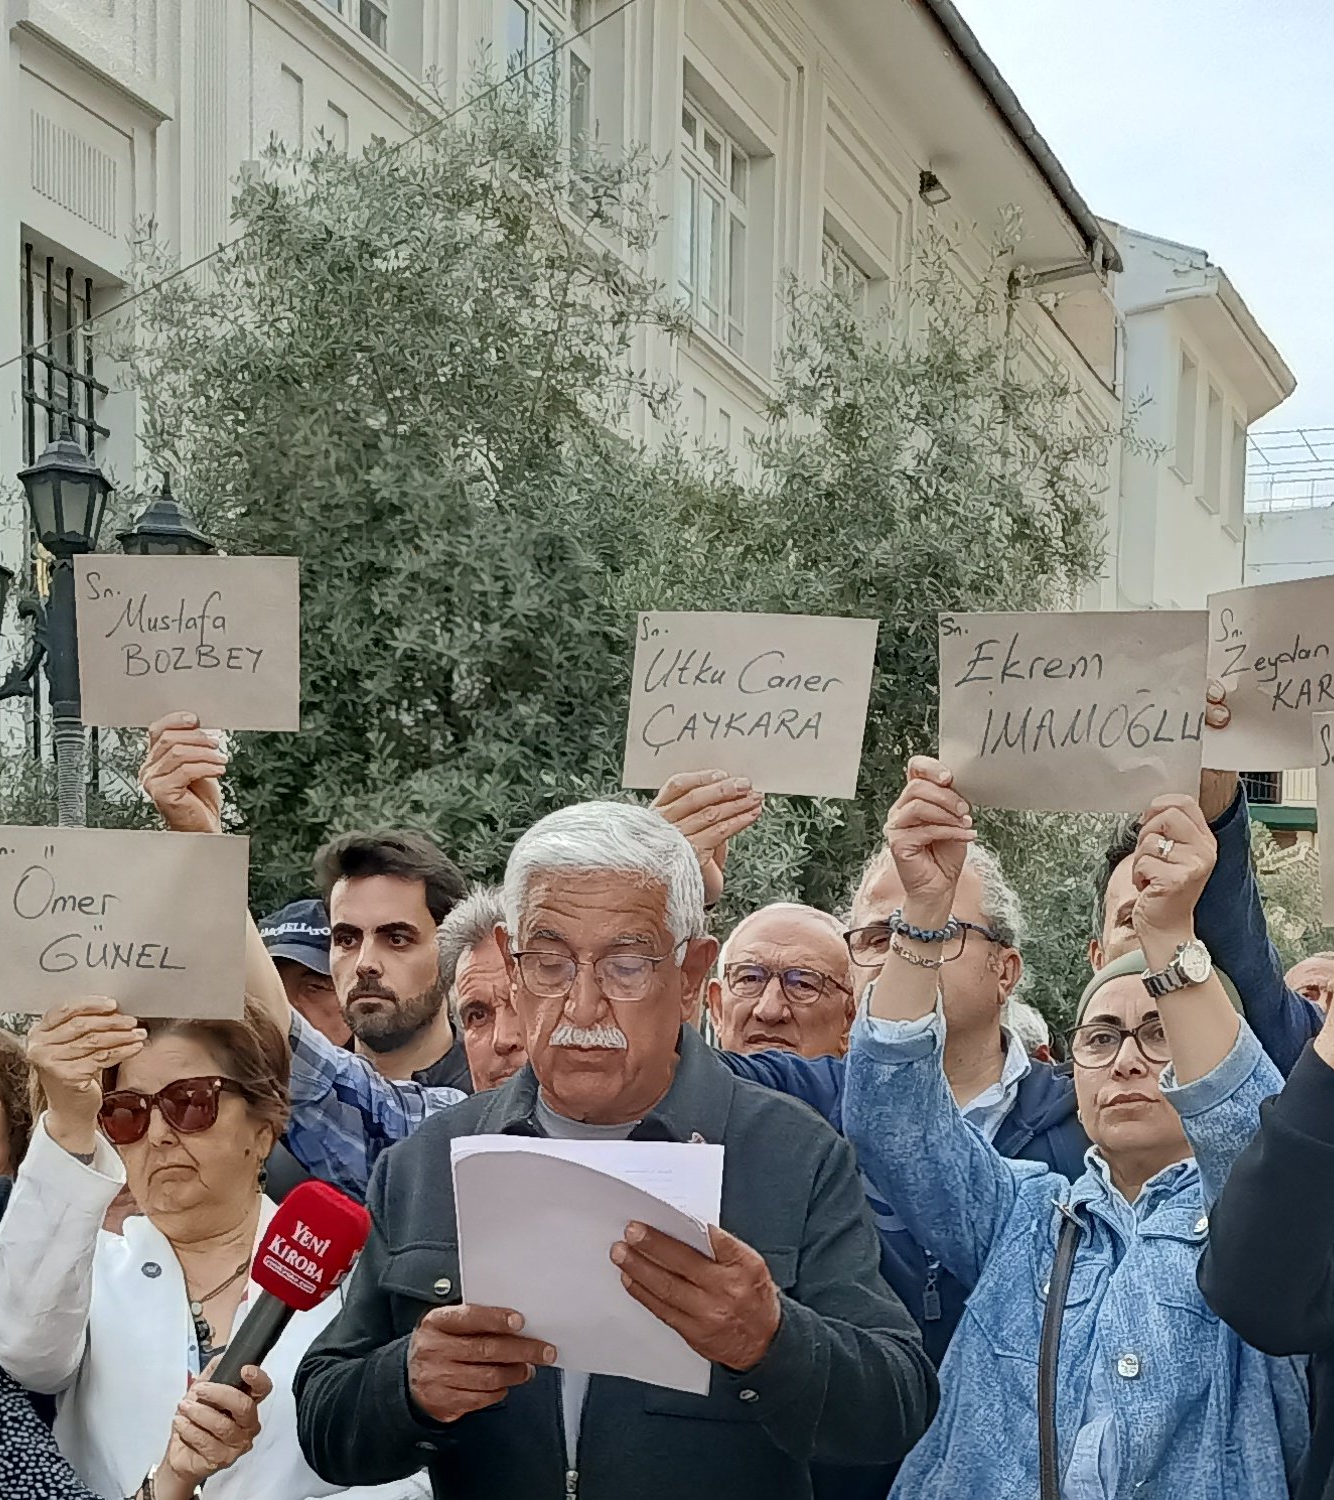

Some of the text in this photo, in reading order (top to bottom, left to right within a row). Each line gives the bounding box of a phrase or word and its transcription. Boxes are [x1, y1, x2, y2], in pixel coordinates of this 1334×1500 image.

[86, 571, 121, 600] Sn.
[105, 590, 226, 645] Mustafa
[640, 616, 669, 642] Sn.
[940, 616, 969, 638] Sn.
[1215, 608, 1242, 642] Sn.
[121, 643, 263, 676] BOZBEY
[644, 648, 842, 695] Utku Caner
[954, 633, 1103, 688] Ekrem
[1220, 634, 1329, 682] Zeydan
[642, 703, 823, 757] ÇAYKARA
[980, 688, 1204, 757] İMAMOĞLU
[13, 844, 121, 920] Ömer
[39, 925, 186, 973] GÜNEL
[267, 1233, 324, 1283] KIROBA
[291, 1220, 331, 1258] YENİ
